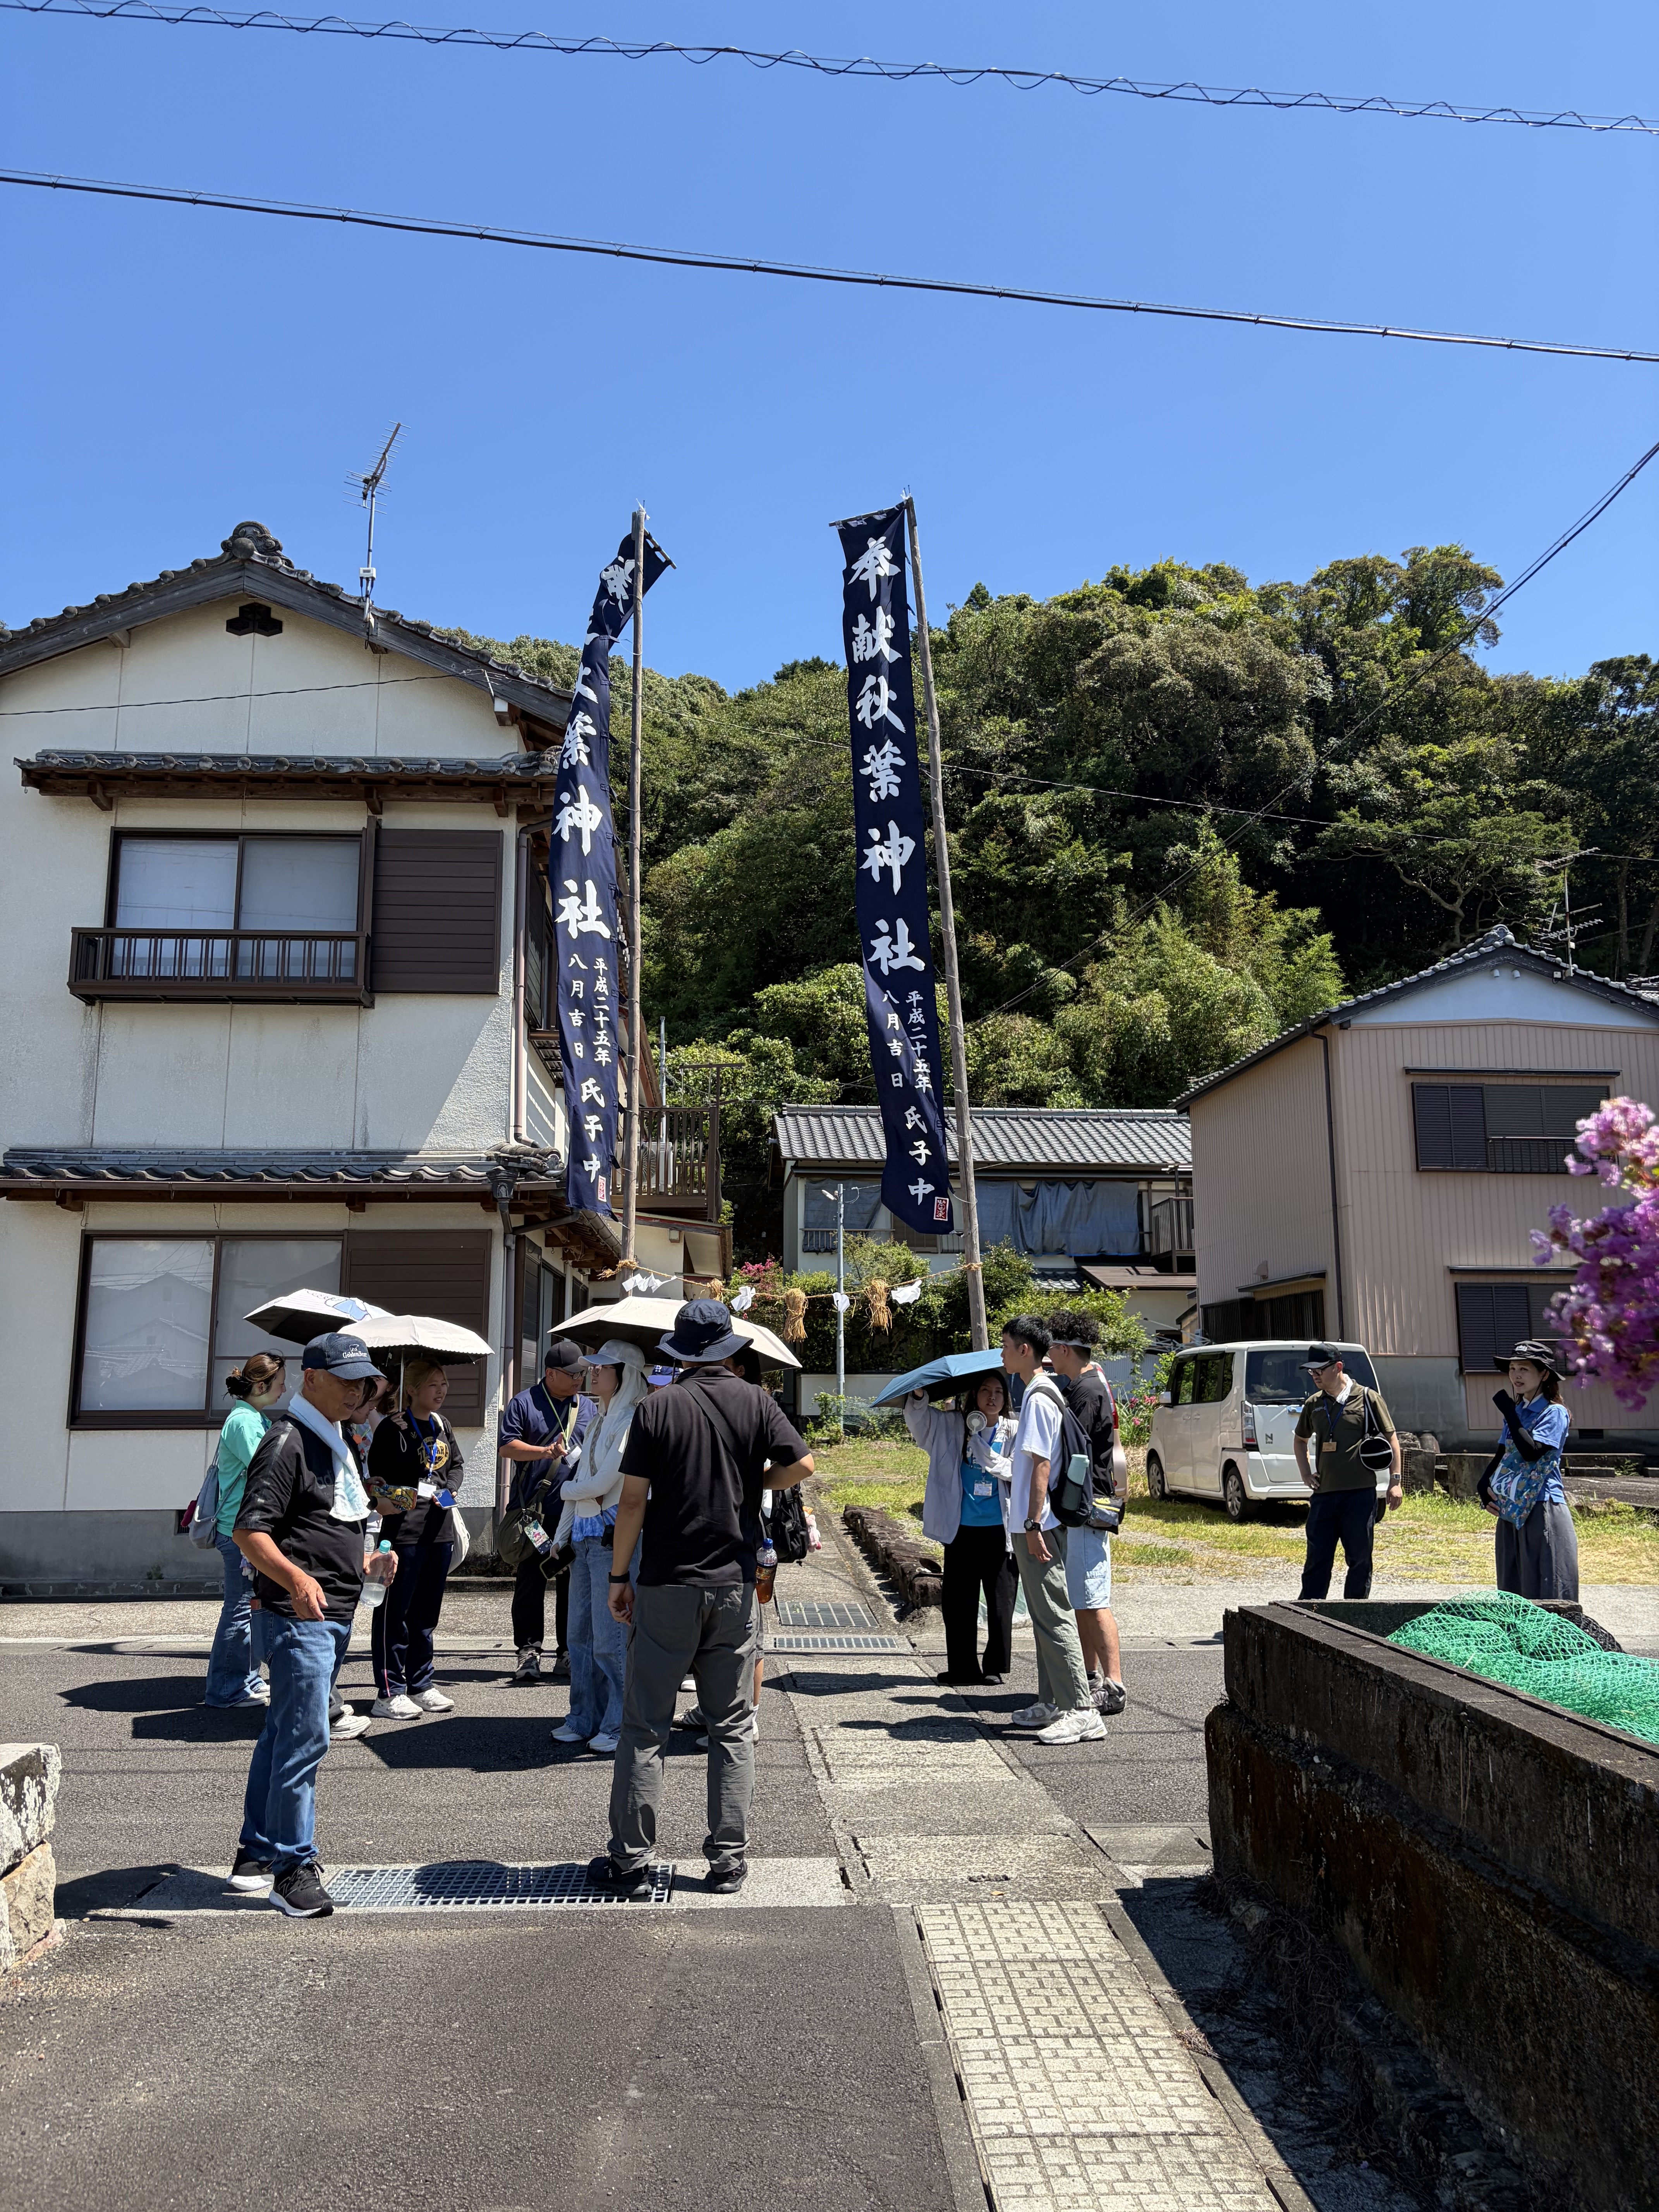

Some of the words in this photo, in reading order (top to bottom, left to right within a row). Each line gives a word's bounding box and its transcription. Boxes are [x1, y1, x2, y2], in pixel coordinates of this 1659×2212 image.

[847, 536, 926, 976] 奉献秋葉神社
[568, 953, 588, 1059] 八月吉日
[594, 957, 612, 1067] 平成二十五年
[882, 989, 903, 1088] 八月吉日
[905, 990, 932, 1094] 平成二十五年
[581, 1077, 606, 1183] 氏子中
[905, 1106, 935, 1206] 氏子中
